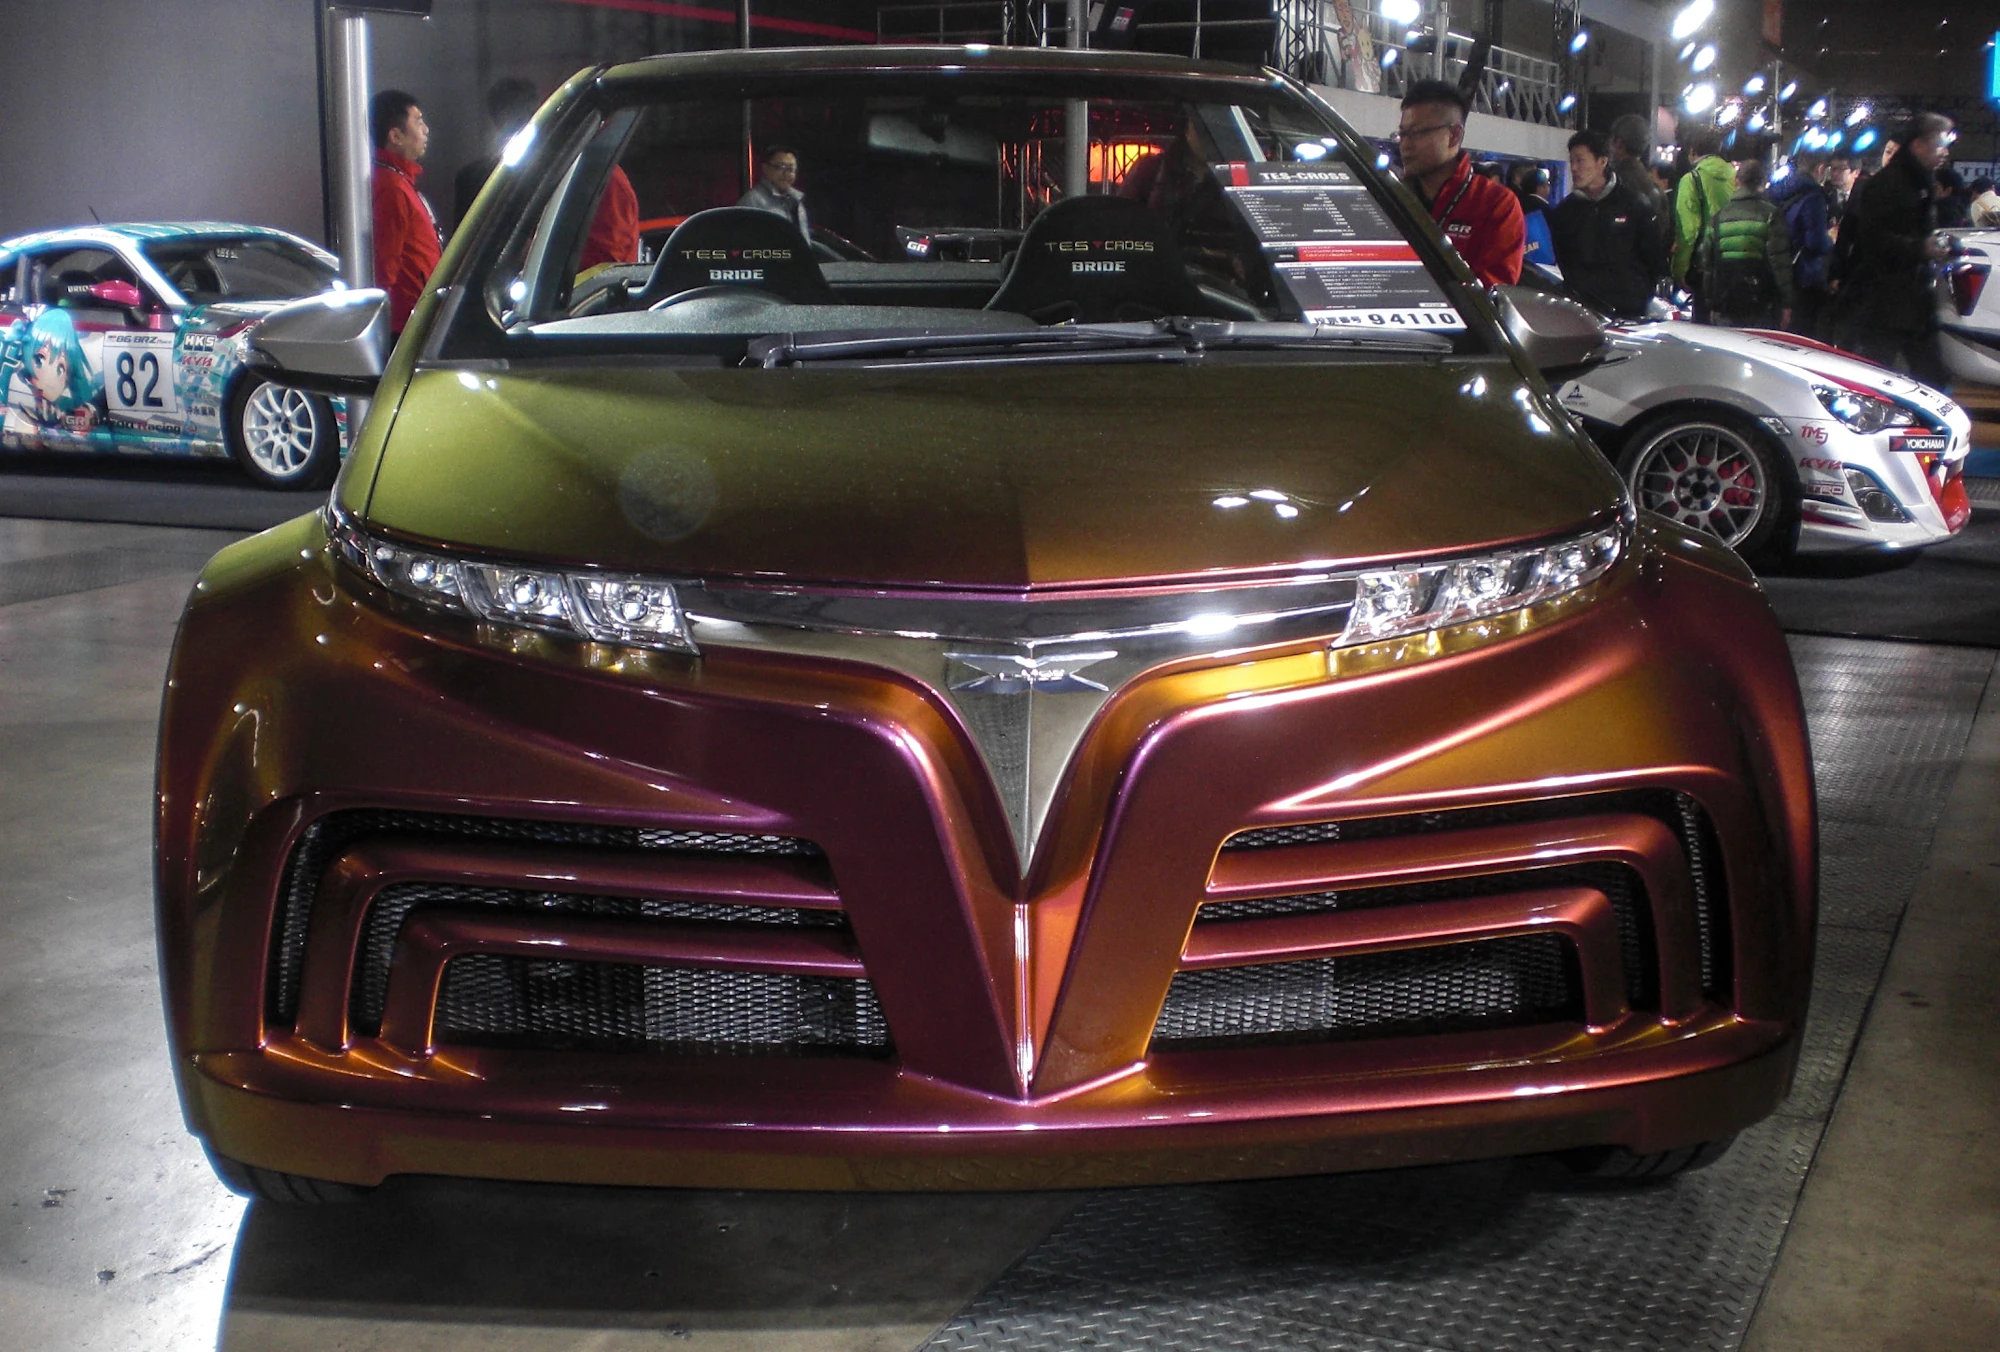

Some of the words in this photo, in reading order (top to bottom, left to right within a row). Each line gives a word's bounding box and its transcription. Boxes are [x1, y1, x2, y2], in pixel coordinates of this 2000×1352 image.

[1259, 172, 1351, 181] TES-CROSS
[1448, 223, 1472, 233] GR
[907, 240, 928, 253] GR
[1045, 241, 1089, 252] TES
[1104, 240, 1154, 252] CROSS
[681, 249, 727, 260] TES
[742, 249, 792, 259] CROSS
[1071, 260, 1126, 272] BRIDE
[708, 268, 764, 280] BRIDE
[67, 285, 95, 293] BRID
[1367, 312, 1457, 325] 94110
[133, 335, 158, 344] BRZ
[184, 334, 215, 347] HKS
[116, 350, 164, 408] 82
[1905, 438, 1945, 449] YOKOHAMA
